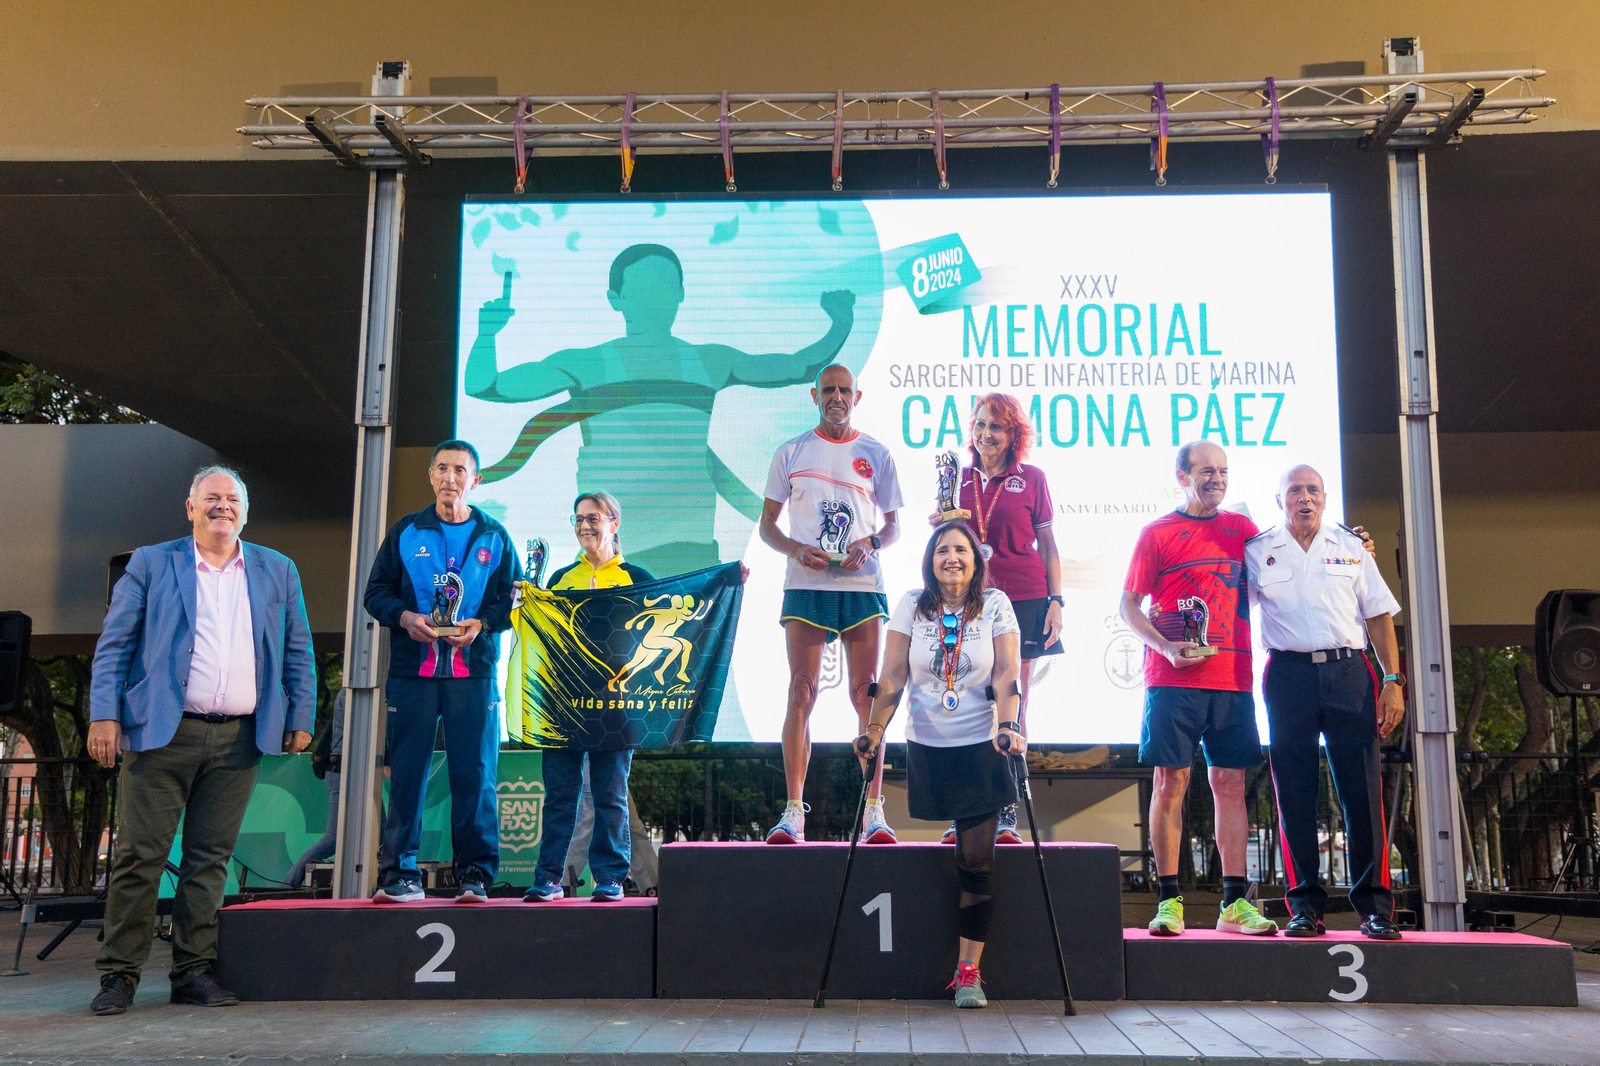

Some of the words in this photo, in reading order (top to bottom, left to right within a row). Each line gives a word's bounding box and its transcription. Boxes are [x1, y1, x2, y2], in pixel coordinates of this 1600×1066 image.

[928, 247, 963, 272] JUNIO
[912, 257, 930, 298] 8
[930, 267, 962, 292] 2024
[1060, 274, 1118, 299] XXXV
[963, 303, 1223, 358] MEMORIAL
[889, 363, 1001, 389] SARGENTO
[1010, 362, 1036, 387] DE
[1045, 354, 1167, 388] INFANTERÍA
[1176, 361, 1201, 386] DE
[1210, 360, 1296, 386] MARINA
[902, 393, 1150, 449] CAONA
[1170, 377, 1288, 448] PÁEZ
[822, 500, 840, 511] 30
[1057, 504, 1158, 515] ANIVERSARIO
[433, 574, 449, 584] 30
[1178, 599, 1194, 609] 30
[571, 696, 604, 709] vida
[608, 698, 644, 710] sana
[648, 699, 657, 712] y
[661, 697, 694, 710] feliz
[501, 801, 538, 815] SAN
[504, 865, 536, 873] Fernand
[861, 892, 893, 952] 1
[414, 922, 456, 983] 2
[1327, 943, 1369, 1002] 3
